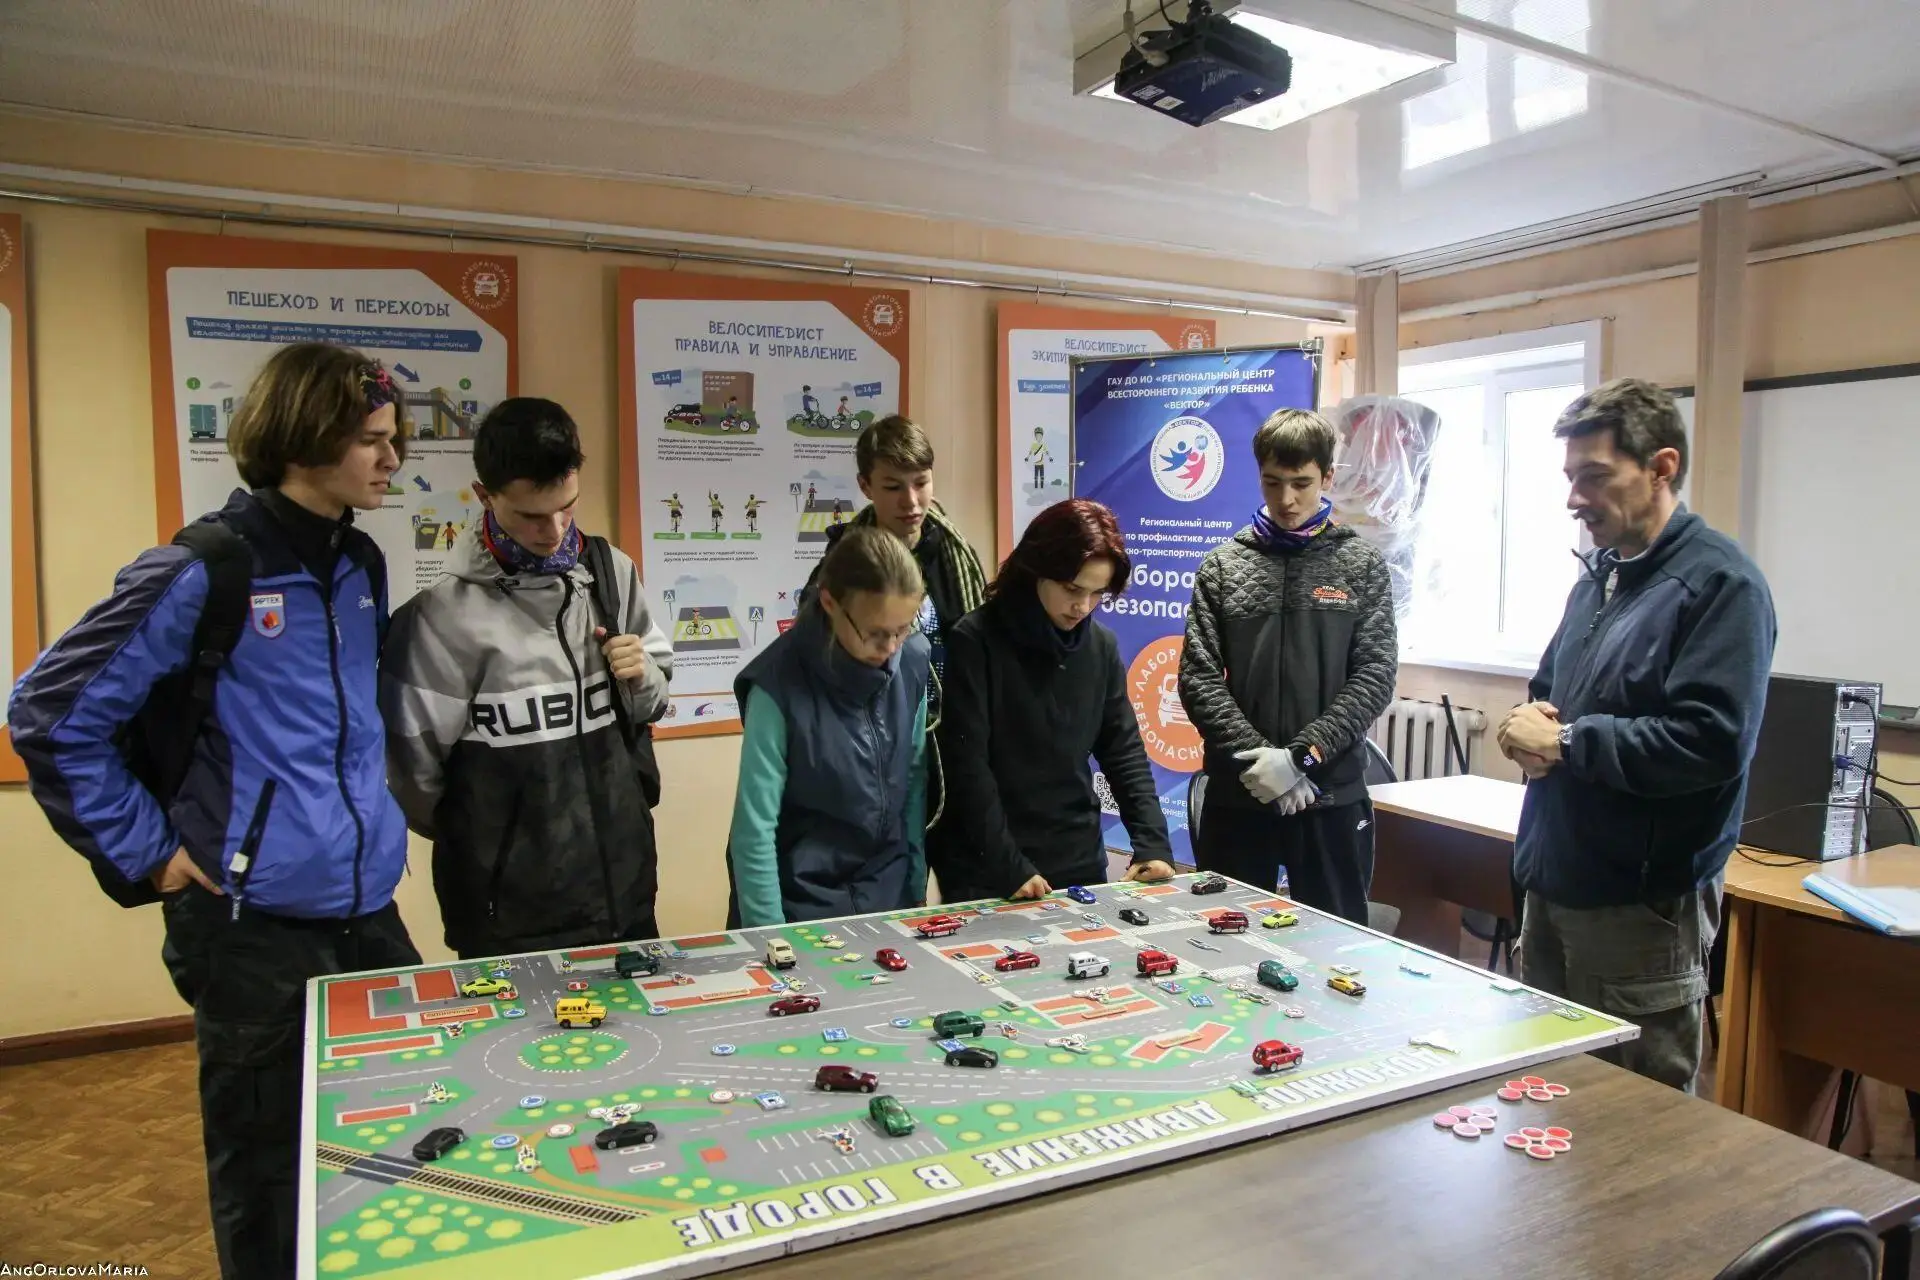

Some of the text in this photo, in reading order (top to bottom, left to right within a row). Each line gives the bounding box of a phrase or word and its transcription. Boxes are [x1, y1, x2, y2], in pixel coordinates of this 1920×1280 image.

[226, 290, 451, 317] ПЕШЕХОД И ПЕРЕХОДЫ
[708, 320, 825, 341] ВЕЛОСИПЕДИСТ
[675, 338, 858, 362] ПРАВИЛА И УПРАВЛЕНИЕ
[1064, 338, 1148, 354] ВЕЛОСИПЕДИСТ
[1107, 368, 1275, 386] ГАУ ДО ИО «РЕГИОНАЛЬНЫЙ ЦЕНТР
[1107, 383, 1274, 399] ВСЕСТОРОННЕГО РАЗВИТИЯ РЕБЕНКА
[1163, 400, 1211, 409] «ВЕКТОР»
[1140, 518, 1232, 531] Региональный центр
[1125, 532, 1235, 544] по профилактике детск
[1128, 564, 1196, 592] бора
[1136, 648, 1177, 692] ЛАБОР
[972, 1100, 1229, 1176] ДВИЖЕНИЕ
[912, 1163, 964, 1190] В
[672, 1177, 898, 1247] ГОРОДЕ
